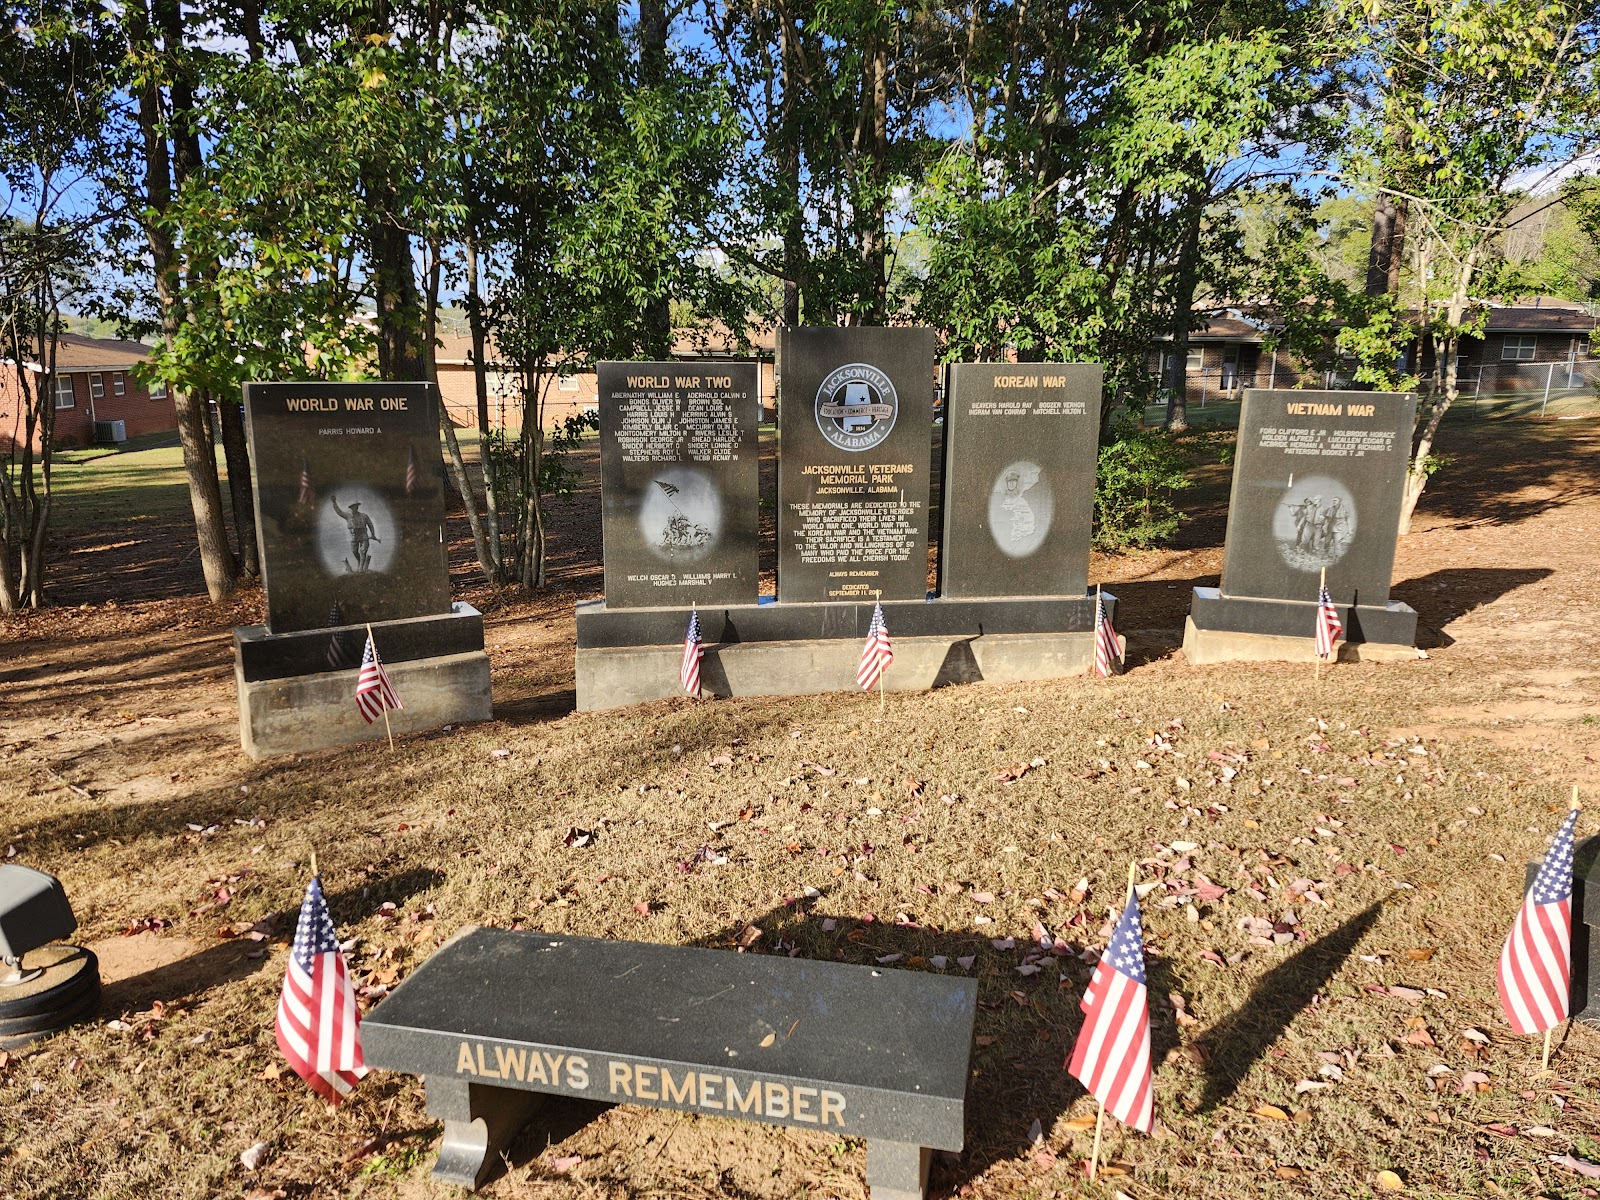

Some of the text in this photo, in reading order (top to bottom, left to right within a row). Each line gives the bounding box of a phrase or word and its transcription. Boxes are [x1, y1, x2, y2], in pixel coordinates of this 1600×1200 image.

[627, 376, 731, 388] WORLD WAR TWO
[823, 368, 890, 396] JACKSONVILLE
[994, 376, 1066, 388] KOREAN WAR
[286, 398, 408, 411] WORLD WAR ONE
[1287, 403, 1376, 416] VIETNAM WAR
[831, 431, 881, 446] ALABAMA
[801, 464, 913, 474] JACKSONVILLE VETERANS
[821, 474, 893, 484] MEMORIAL PARK
[456, 1041, 847, 1127] ALWAYS REMEMBER
